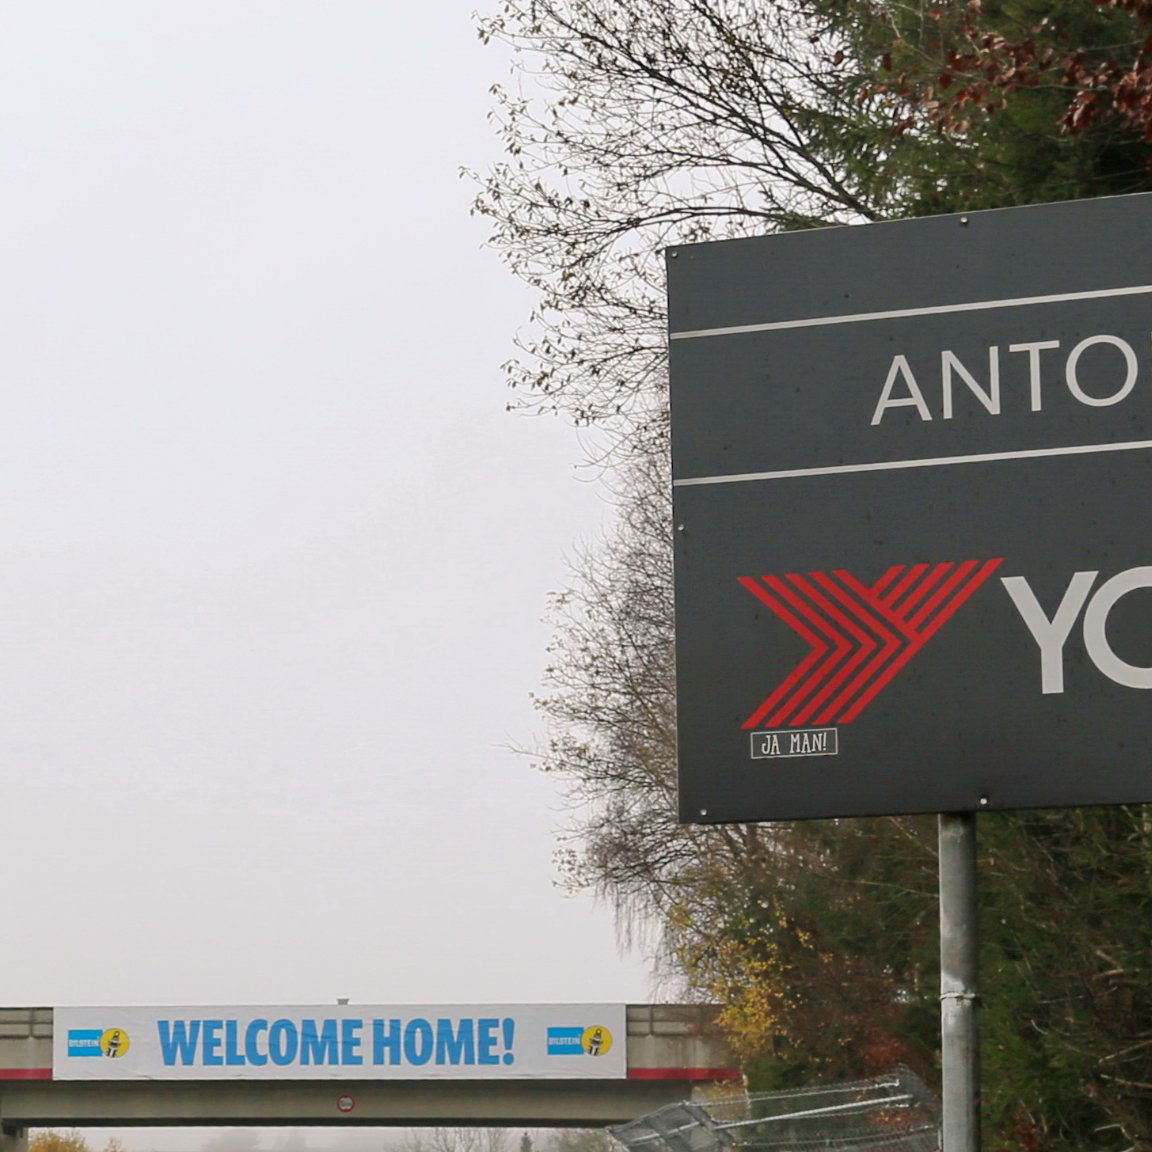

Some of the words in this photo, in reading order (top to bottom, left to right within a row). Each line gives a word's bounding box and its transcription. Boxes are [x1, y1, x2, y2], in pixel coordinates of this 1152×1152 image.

[870, 333, 1152, 426] ANTO
[761, 734, 781, 755] JA
[789, 732, 827, 754] MAN!
[157, 1019, 363, 1067] WELCOME
[373, 1018, 515, 1066] HOME!
